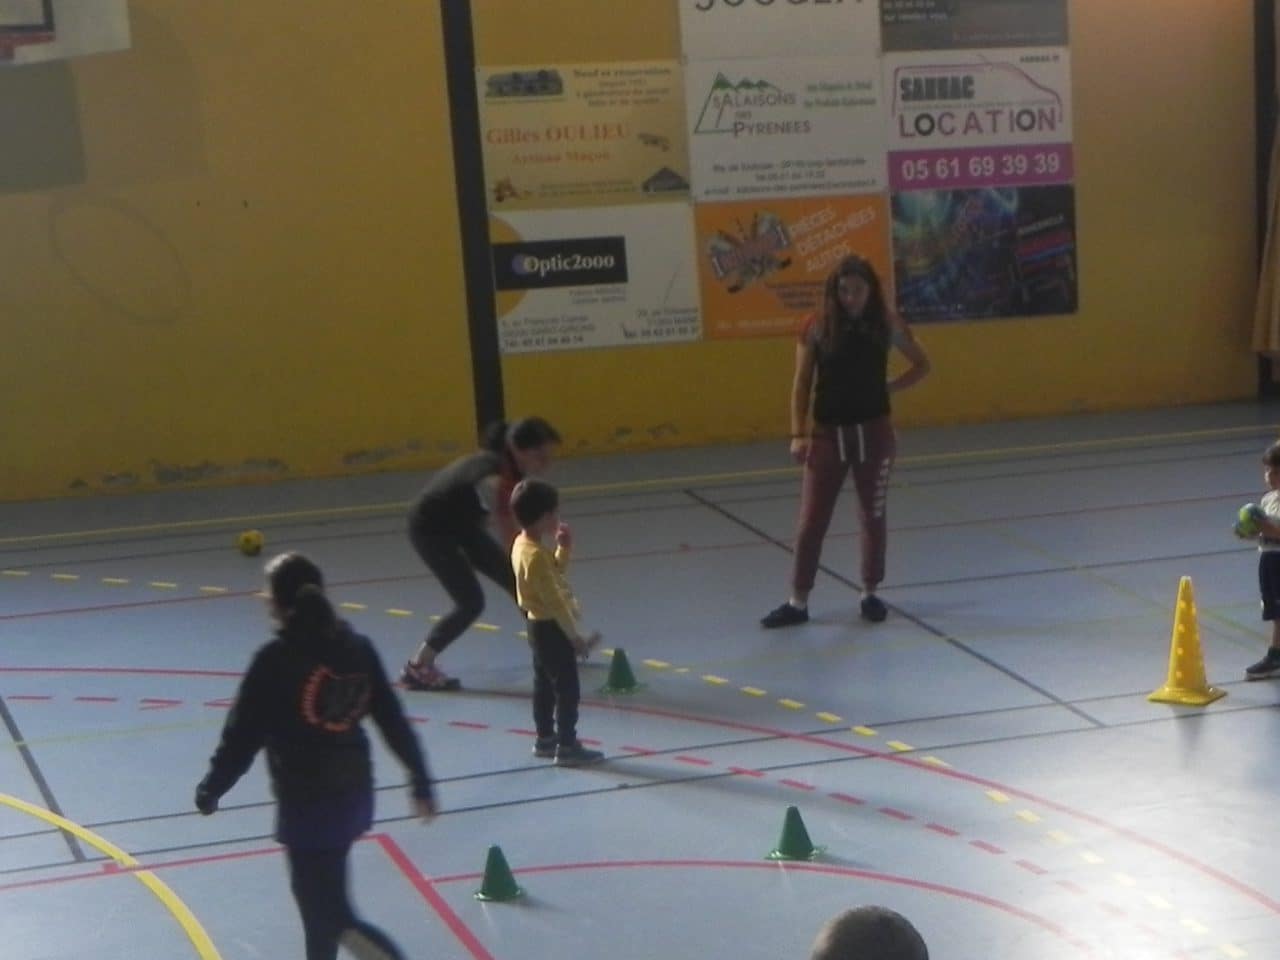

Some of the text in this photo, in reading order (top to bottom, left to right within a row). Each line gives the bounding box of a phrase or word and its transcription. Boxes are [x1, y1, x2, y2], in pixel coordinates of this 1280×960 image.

[712, 91, 797, 109] SALAISONS
[898, 106, 1056, 138] LOCATION
[901, 151, 1061, 181] 05 61 69 39 39
[523, 253, 616, 277] Optic2000
